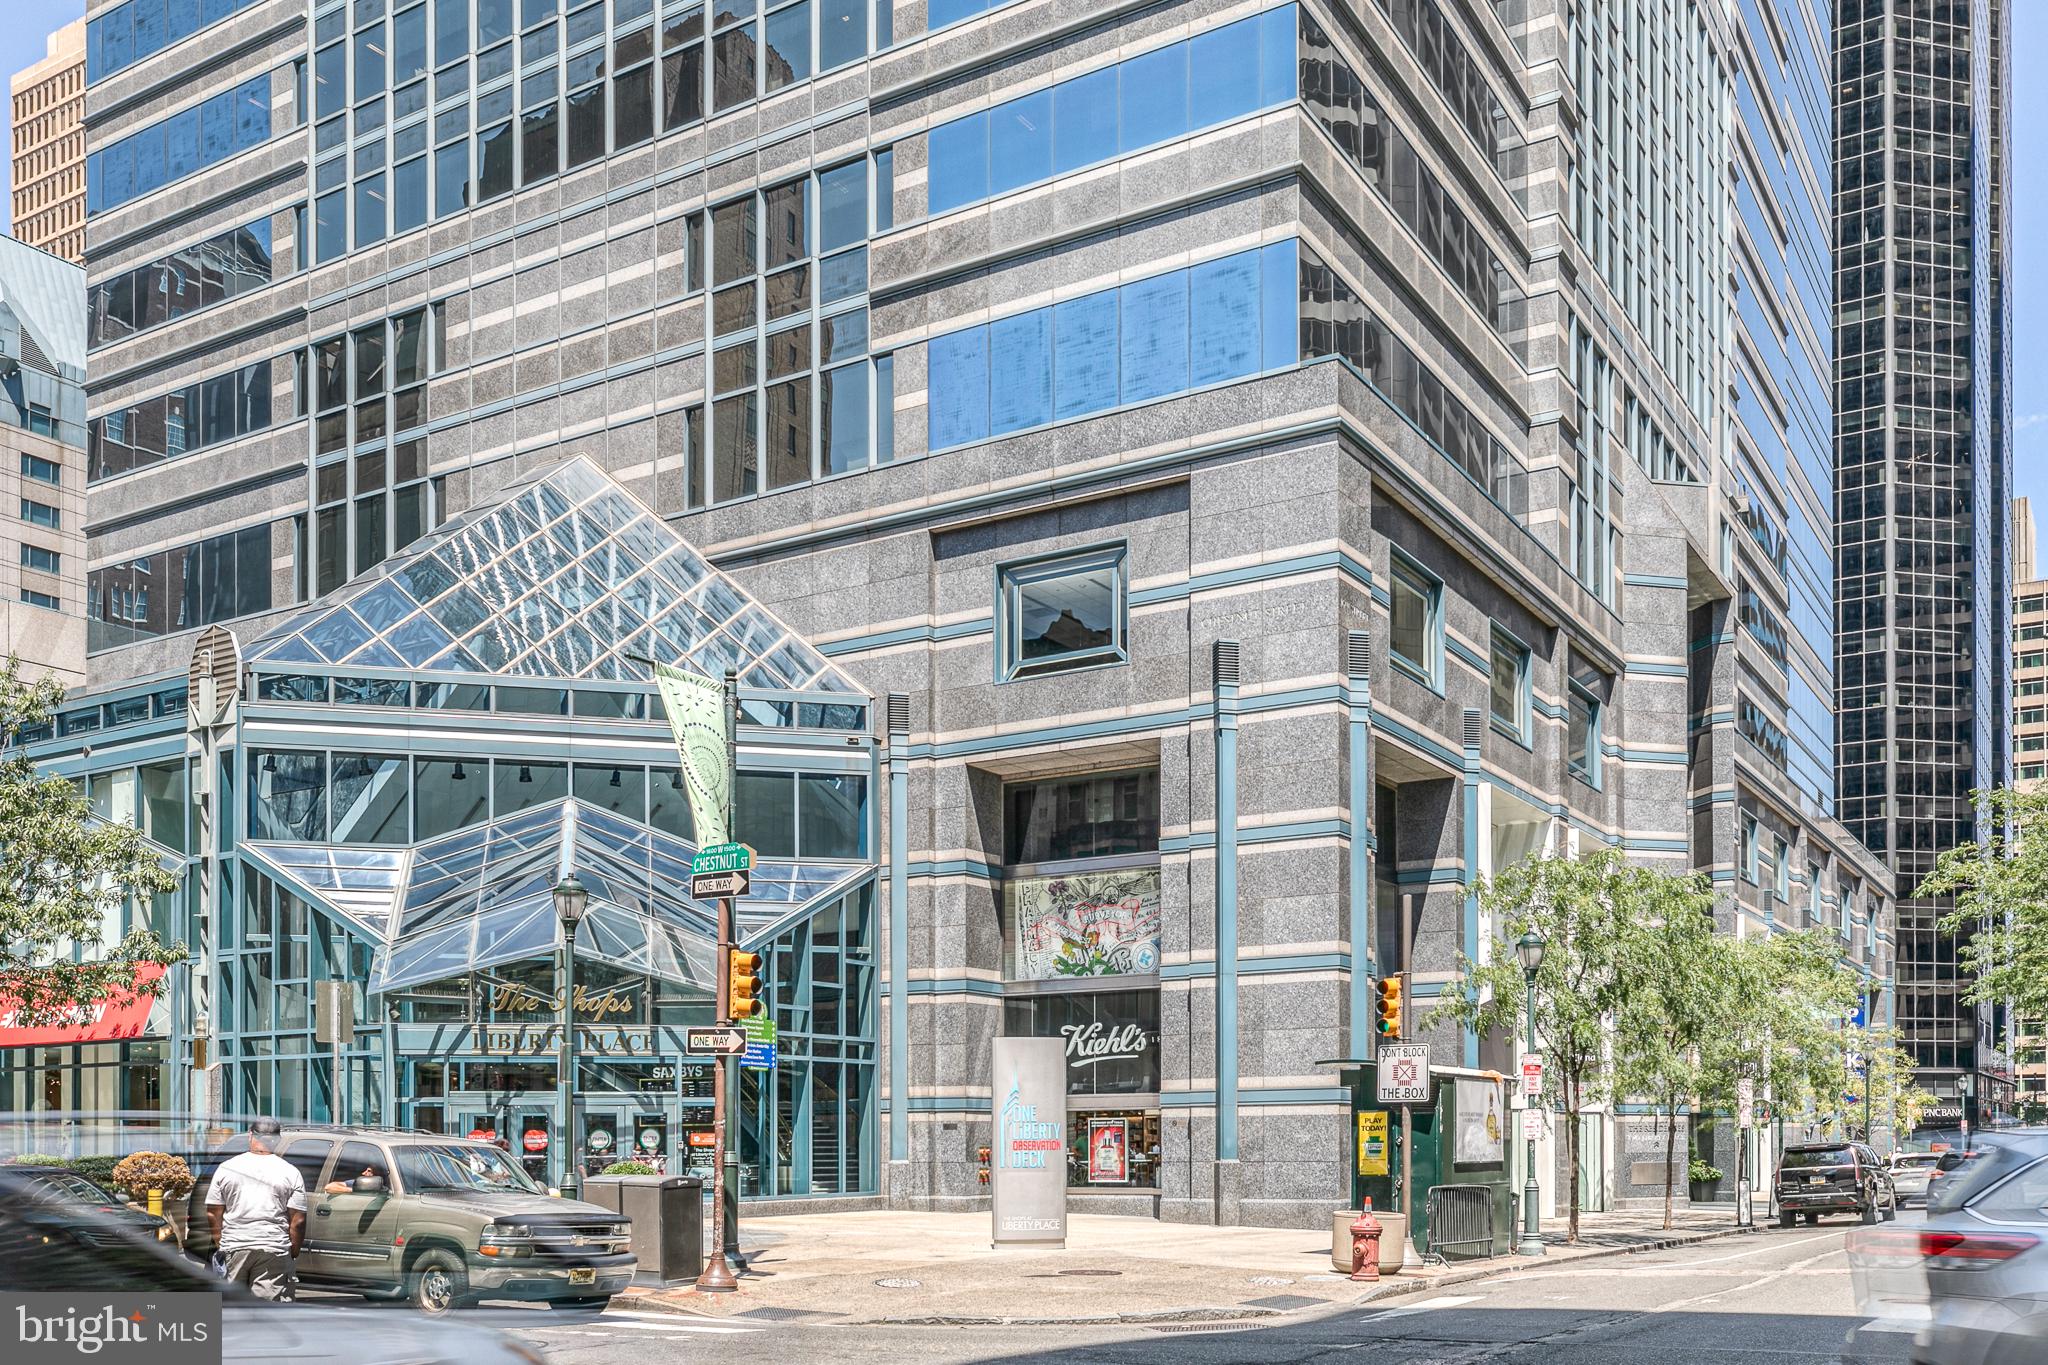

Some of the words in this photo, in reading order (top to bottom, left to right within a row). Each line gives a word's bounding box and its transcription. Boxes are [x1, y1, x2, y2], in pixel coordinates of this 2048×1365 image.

[694, 853, 738, 872] CHESTNUT
[741, 856, 748, 868] ST
[697, 881, 713, 892] ONE
[715, 879, 733, 890] WAY
[488, 983, 540, 1012] The
[584, 1032, 656, 1051] PLACE
[693, 1036, 710, 1047] ONE
[712, 1036, 729, 1046] WAY
[1060, 1022, 1147, 1057] Kiehl's
[1403, 1047, 1426, 1058] BLOCK
[652, 1065, 703, 1079] SAXBYS
[1381, 1087, 1400, 1098] THE
[1404, 1087, 1425, 1098] BOX
[1012, 1104, 1037, 1122] ONE
[1923, 1108, 1941, 1117] PNC
[1941, 1108, 1963, 1117] BANK
[1012, 1140, 1061, 1151] OBSERVATION
[1012, 1150, 1045, 1168] DECK
[1034, 1220, 1061, 1230] PLACE
